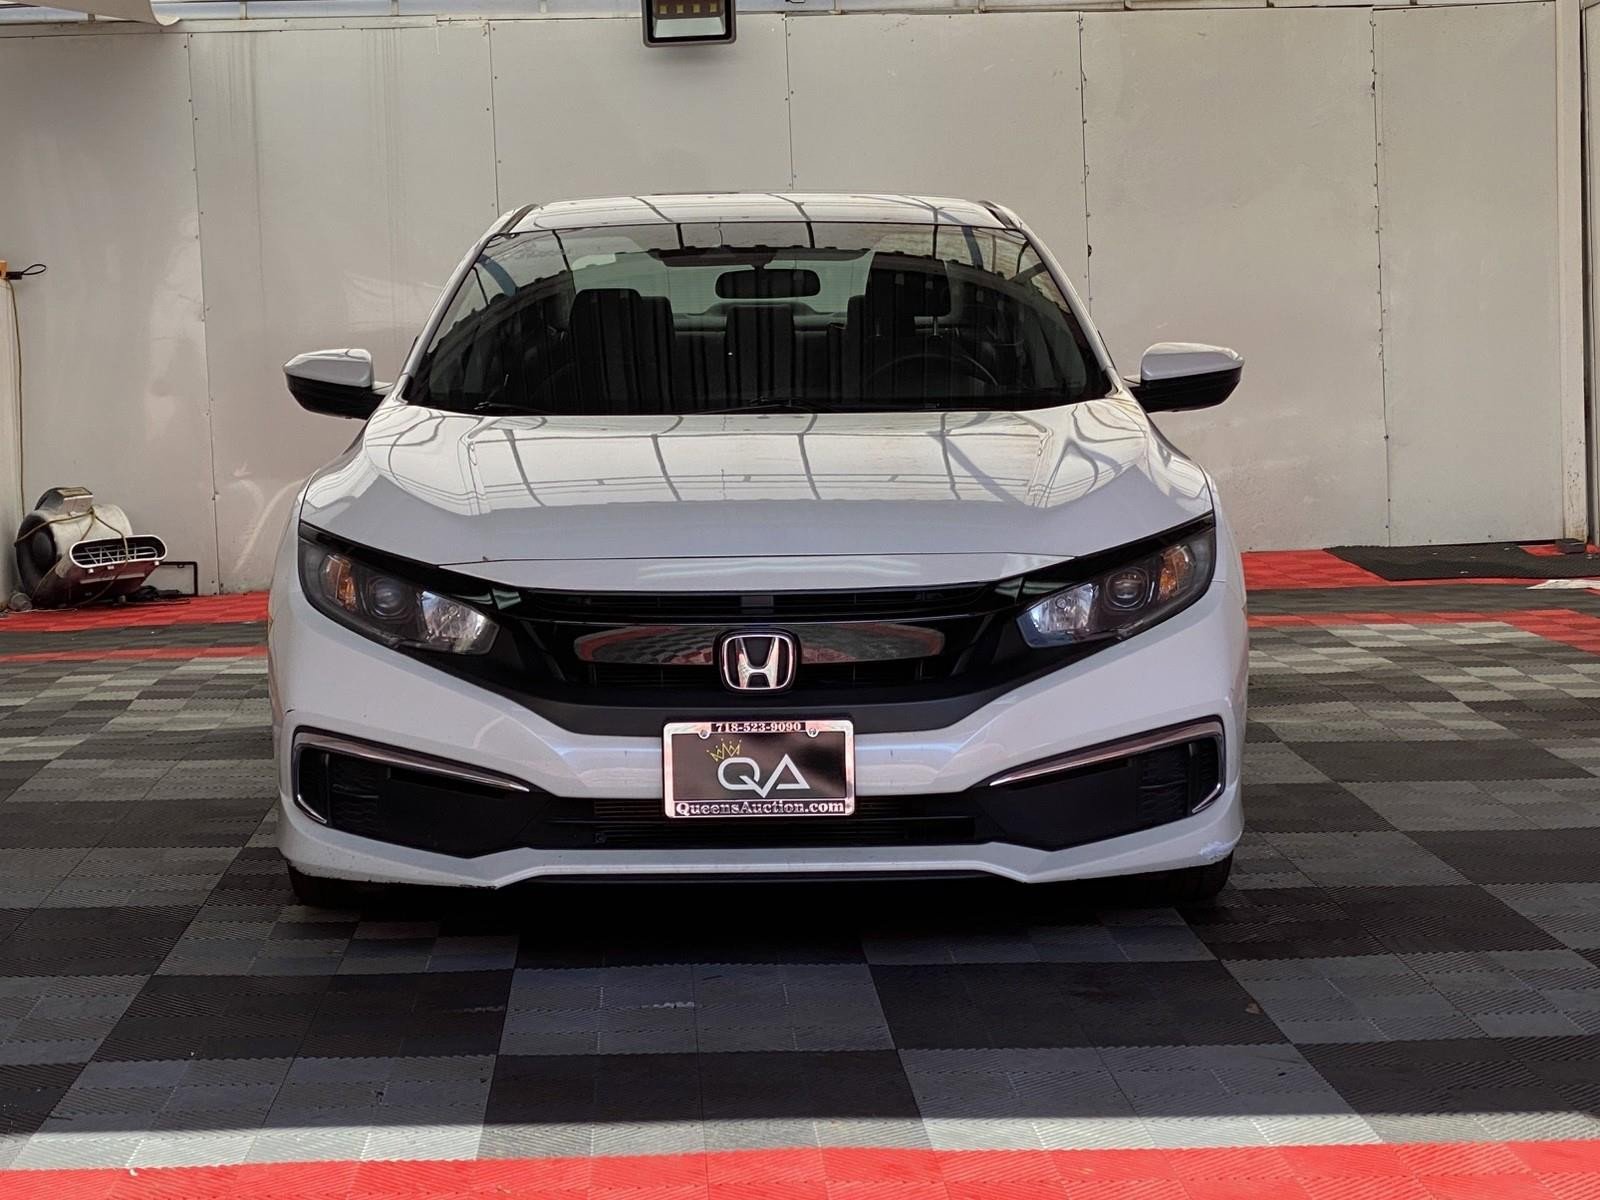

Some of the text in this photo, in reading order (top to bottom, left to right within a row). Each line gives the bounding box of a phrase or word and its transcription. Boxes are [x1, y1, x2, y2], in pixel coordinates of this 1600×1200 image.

[716, 721, 802, 733] 718-523-9090
[717, 753, 811, 798] QA
[675, 800, 845, 816] QueensAuction.com
